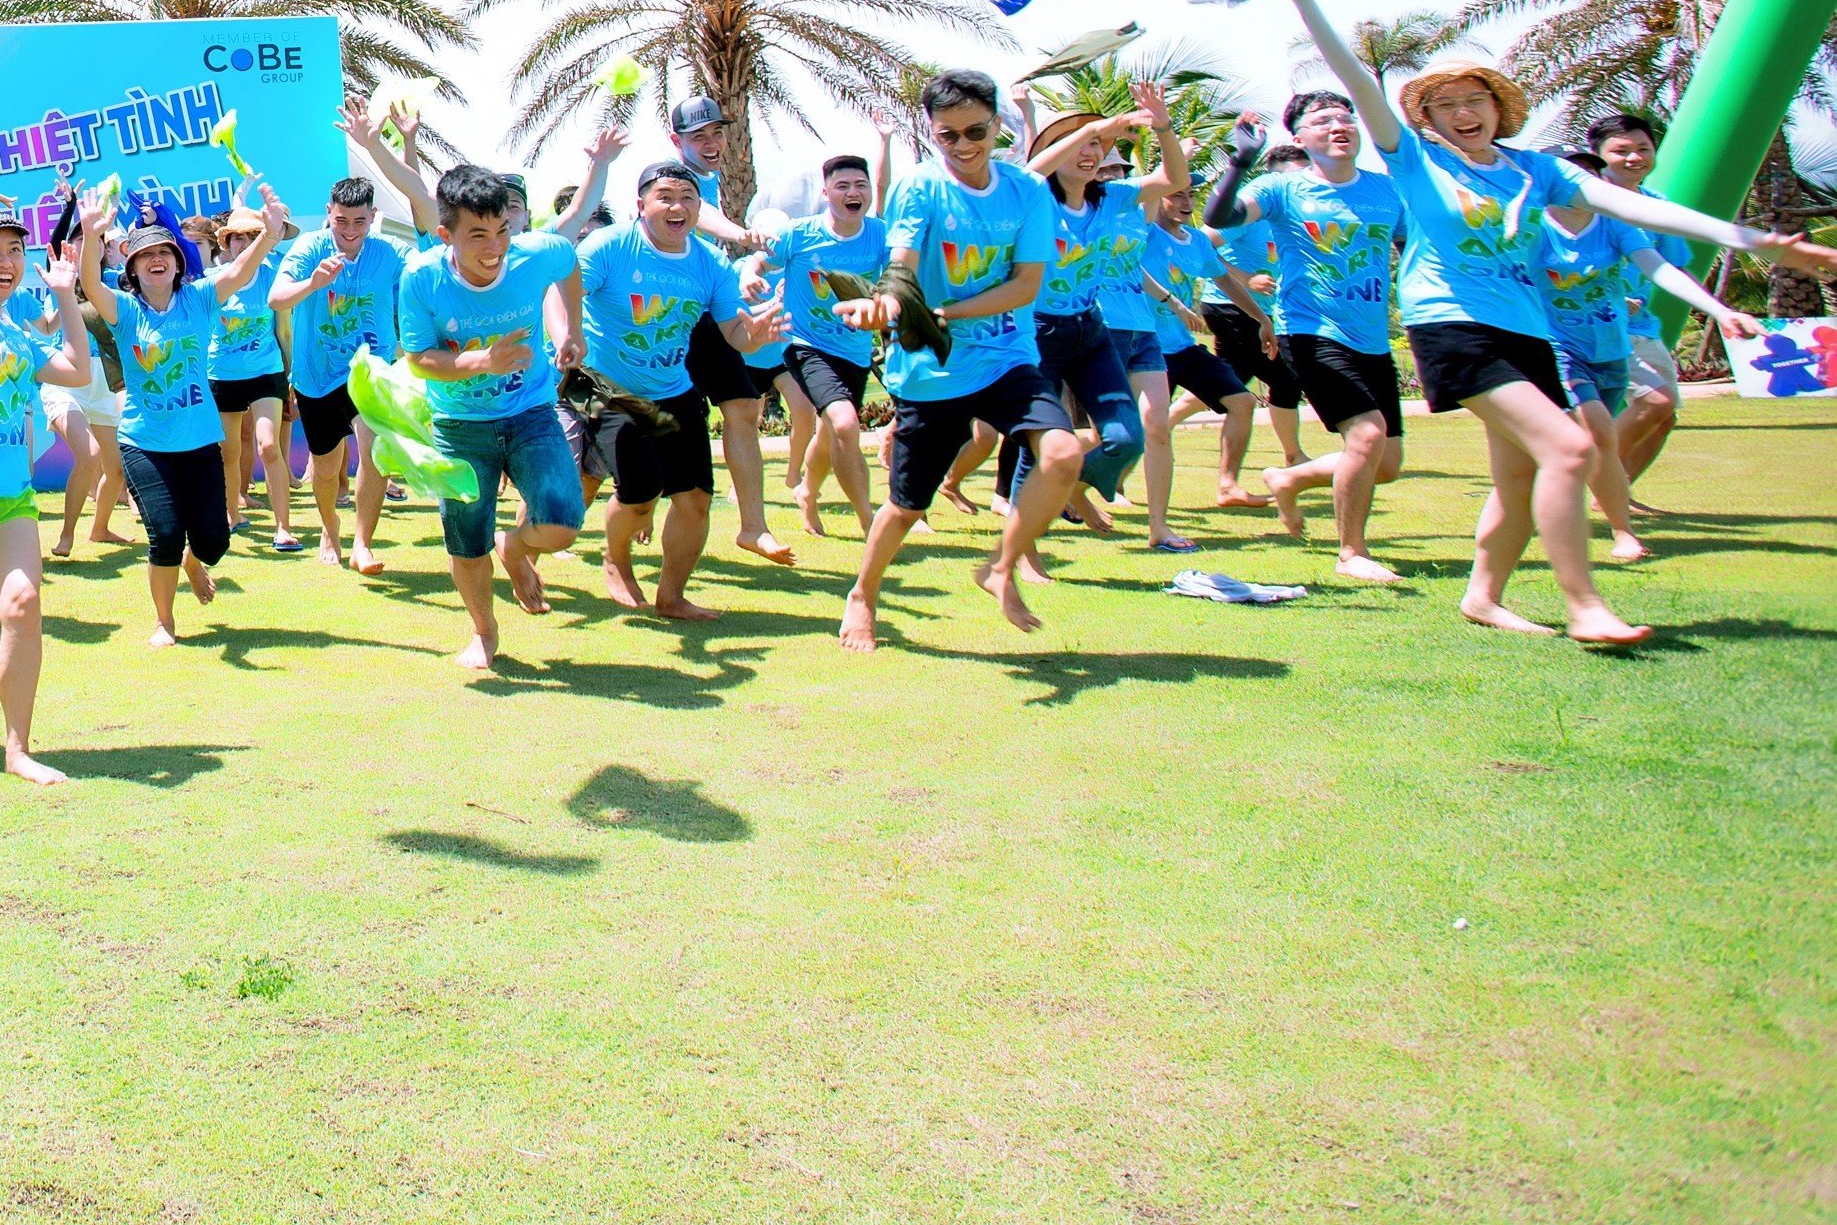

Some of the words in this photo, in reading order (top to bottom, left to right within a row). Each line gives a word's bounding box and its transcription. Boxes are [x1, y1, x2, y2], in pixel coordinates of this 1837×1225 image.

[203, 32, 273, 45] MEMBER
[281, 31, 300, 42] OF
[260, 73, 304, 83] GROUP
[103, 81, 225, 154] TÌNH
[690, 108, 712, 123] NIKE
[1302, 220, 1391, 254] WE
[328, 290, 375, 317] WE
[629, 293, 703, 327] WE
[220, 315, 271, 335] WE
[317, 310, 377, 340] ARE
[132, 333, 200, 373] WE
[141, 356, 199, 395] ARE
[143, 383, 204, 412] ONE
